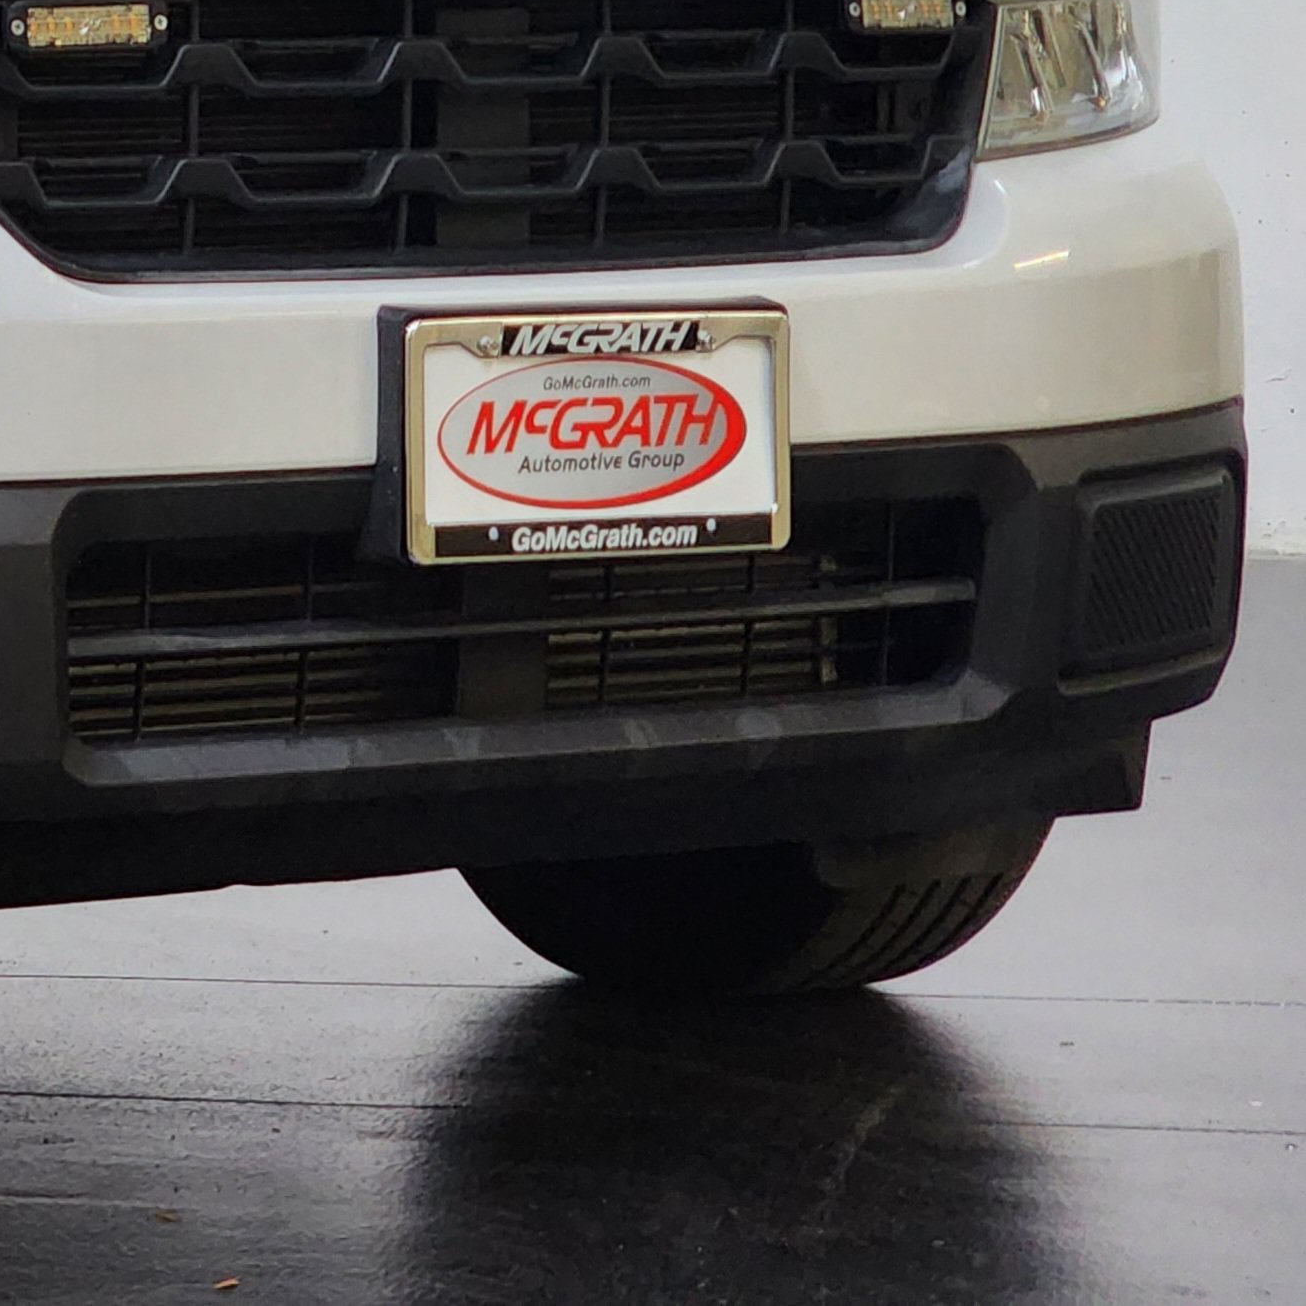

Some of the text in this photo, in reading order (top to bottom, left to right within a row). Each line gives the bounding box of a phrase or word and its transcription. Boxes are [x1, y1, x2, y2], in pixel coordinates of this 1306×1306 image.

[542, 373, 651, 392] GoMcGrath.com
[518, 449, 685, 474] Automotive Group
[511, 523, 698, 552] GoMcGrath.com
